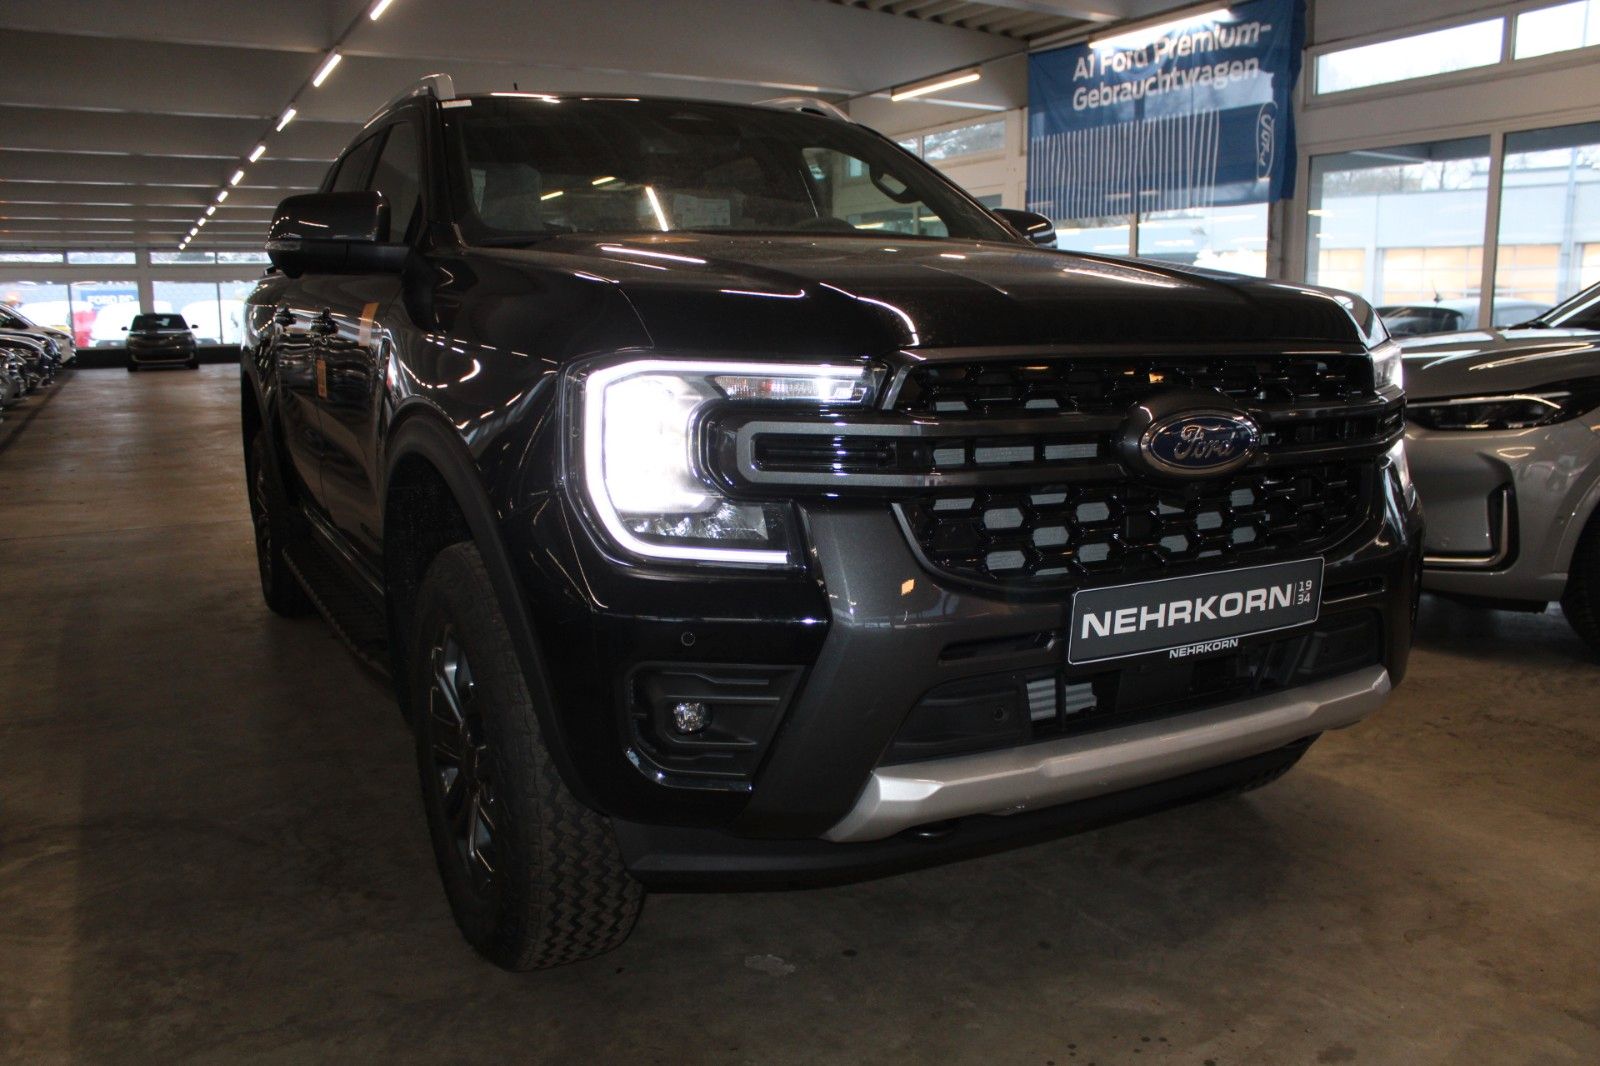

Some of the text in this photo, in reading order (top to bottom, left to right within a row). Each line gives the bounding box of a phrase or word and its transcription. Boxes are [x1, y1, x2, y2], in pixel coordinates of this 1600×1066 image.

[1101, 44, 1149, 75] Ford
[1153, 21, 1271, 64] Premium-
[1073, 57, 1259, 111] Gebrauchtwagen
[1174, 424, 1238, 460] Ford
[1081, 580, 1312, 639] NEHRKORN 19
[1297, 593, 1311, 605] 34
[1169, 638, 1239, 659] NEHRKORN
